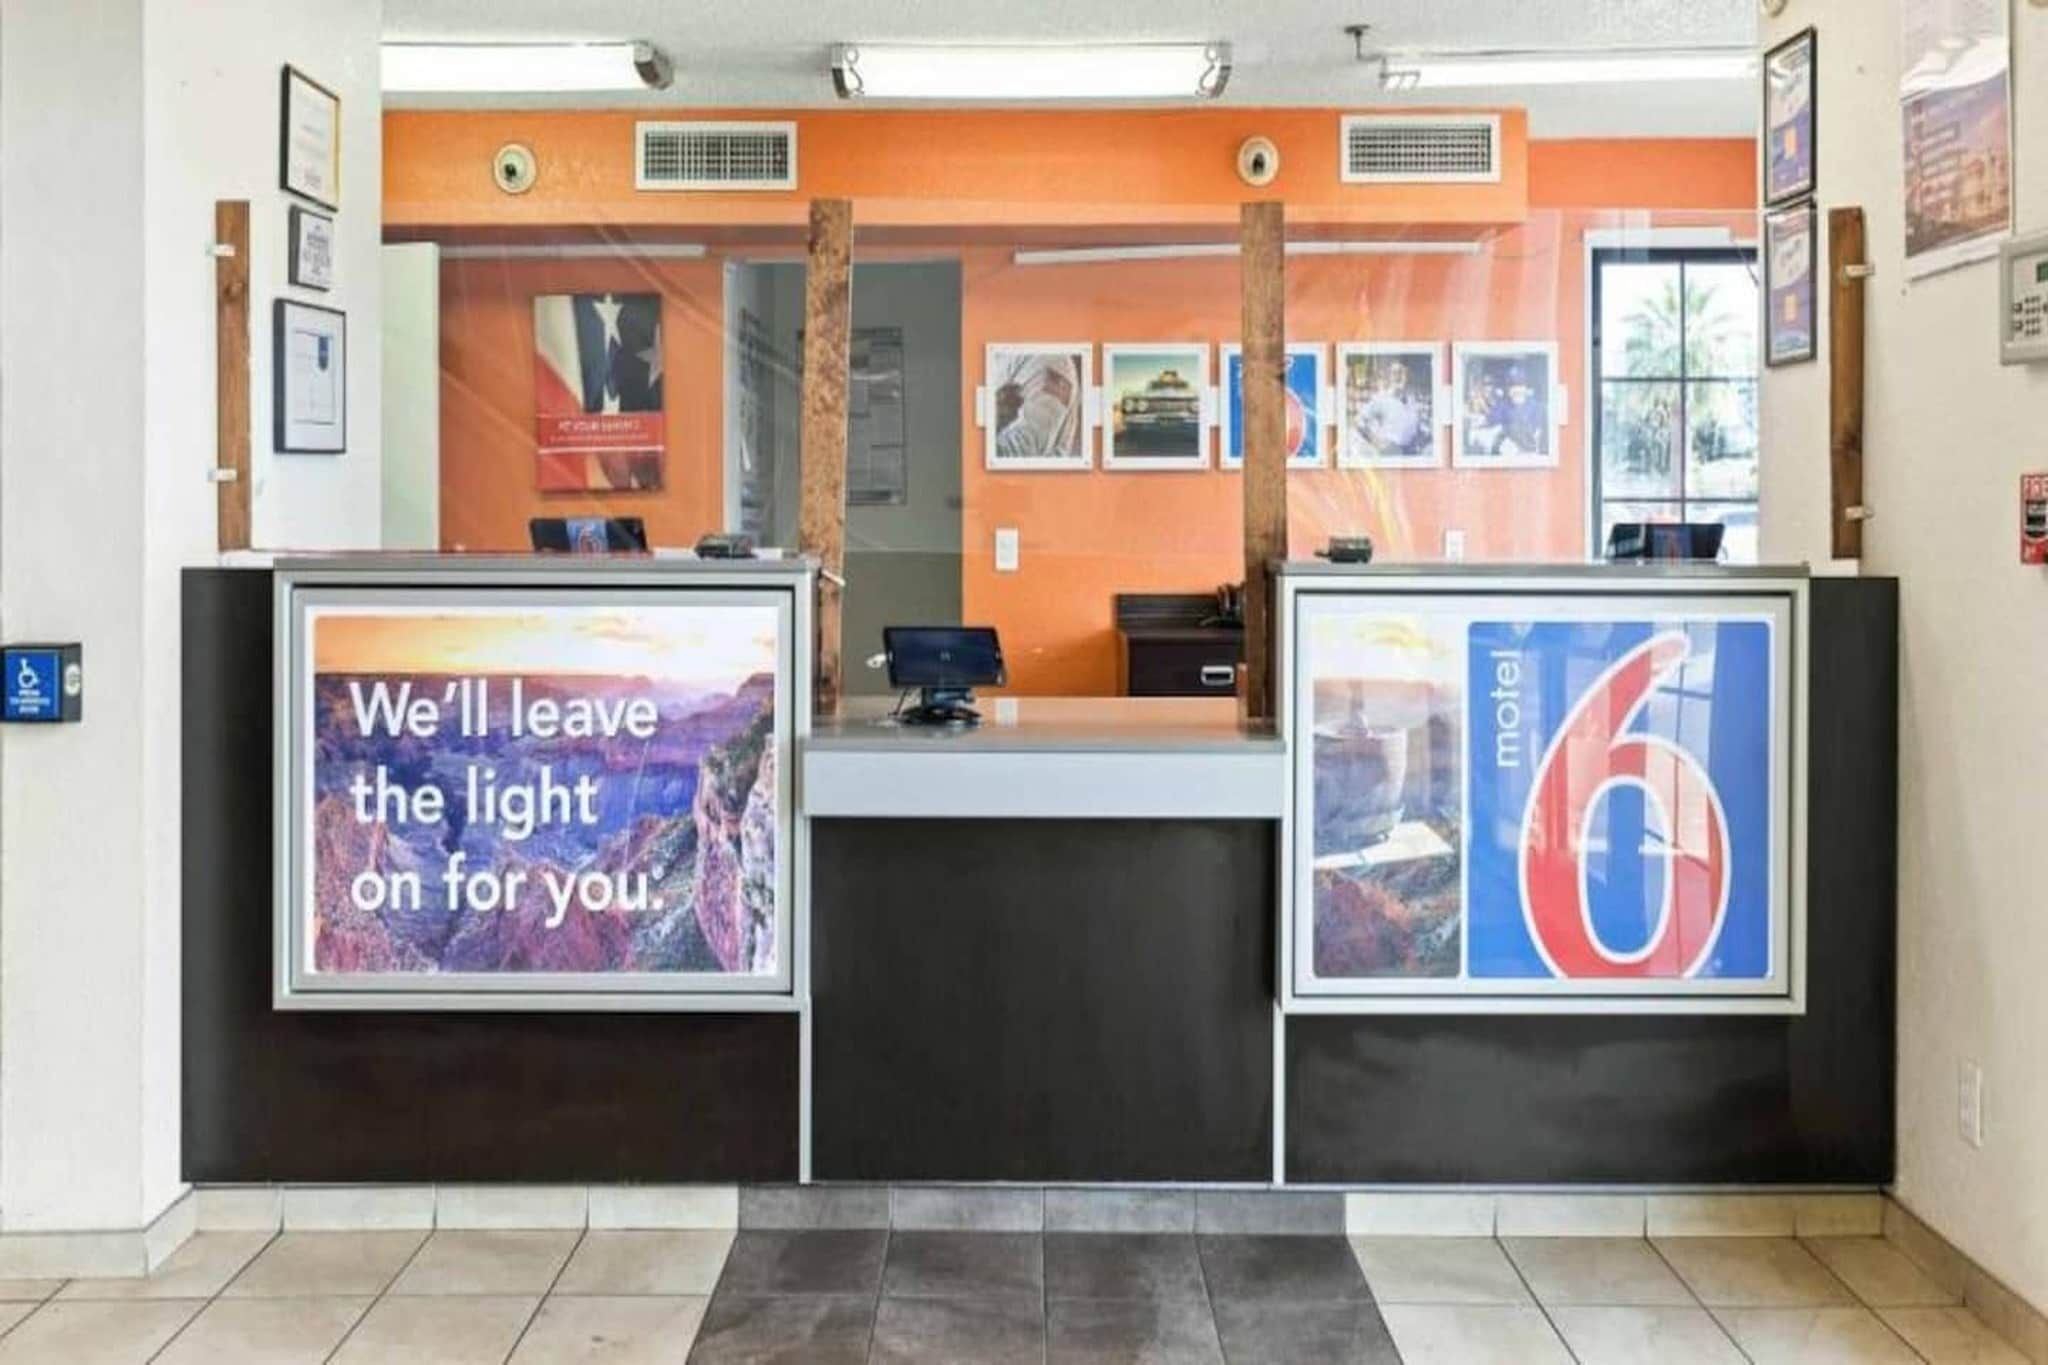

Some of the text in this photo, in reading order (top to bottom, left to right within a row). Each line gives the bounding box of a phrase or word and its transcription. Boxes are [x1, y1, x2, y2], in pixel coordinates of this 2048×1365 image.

[350, 678, 659, 737] We’ll leave
[1490, 650, 1520, 767] motel
[350, 765, 599, 841] the light
[1518, 630, 1731, 978] 6
[351, 870, 421, 911] on
[443, 851, 527, 911] for
